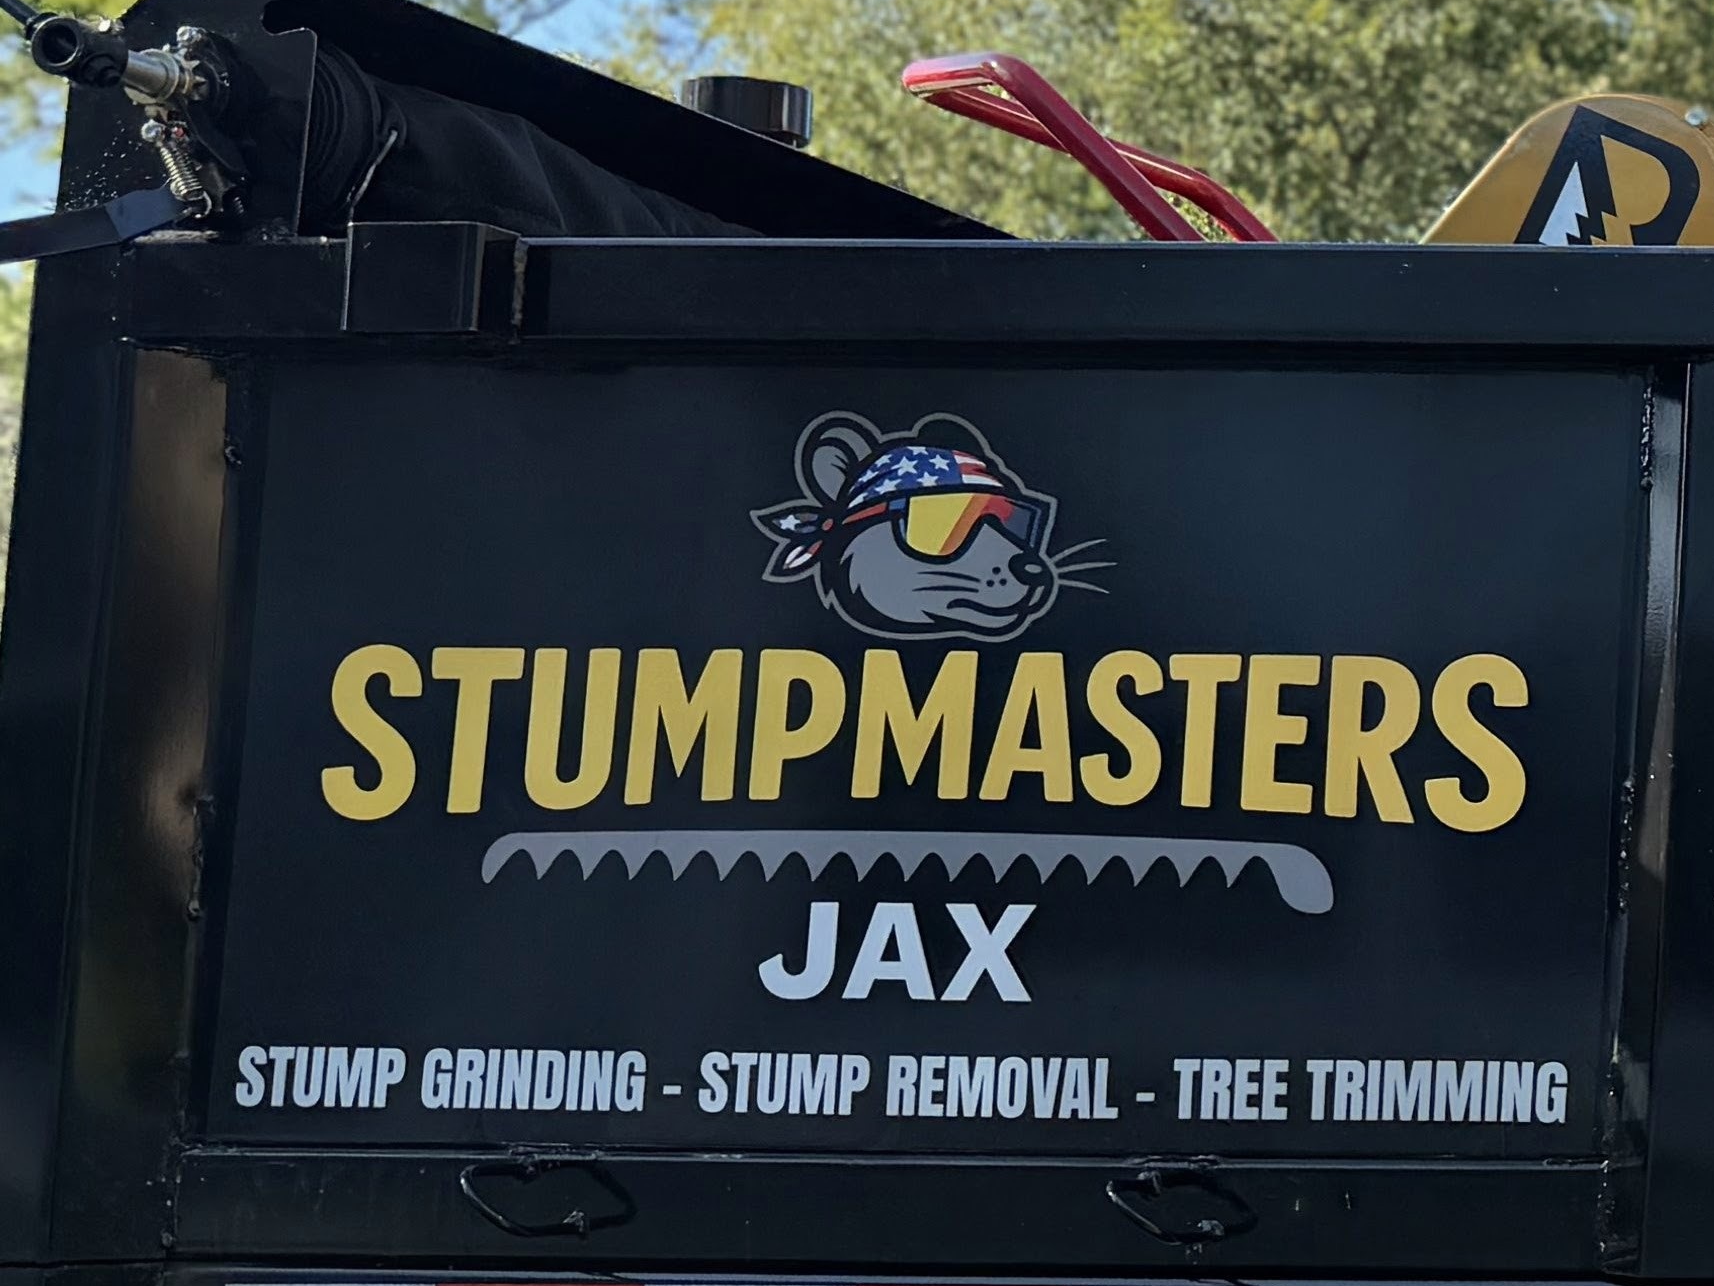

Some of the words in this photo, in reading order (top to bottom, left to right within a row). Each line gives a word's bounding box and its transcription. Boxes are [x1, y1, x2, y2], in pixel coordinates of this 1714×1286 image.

[322, 645, 1528, 832] STUMPMASTERS
[759, 902, 1036, 1001] JAX
[236, 1046, 406, 1107] STUMP
[421, 1048, 646, 1111] GRINDING
[699, 1052, 870, 1115] STUMP
[886, 1055, 1118, 1119] REMOVAL
[1174, 1059, 1289, 1120] TREE
[1307, 1060, 1567, 1123] TRIMMING
